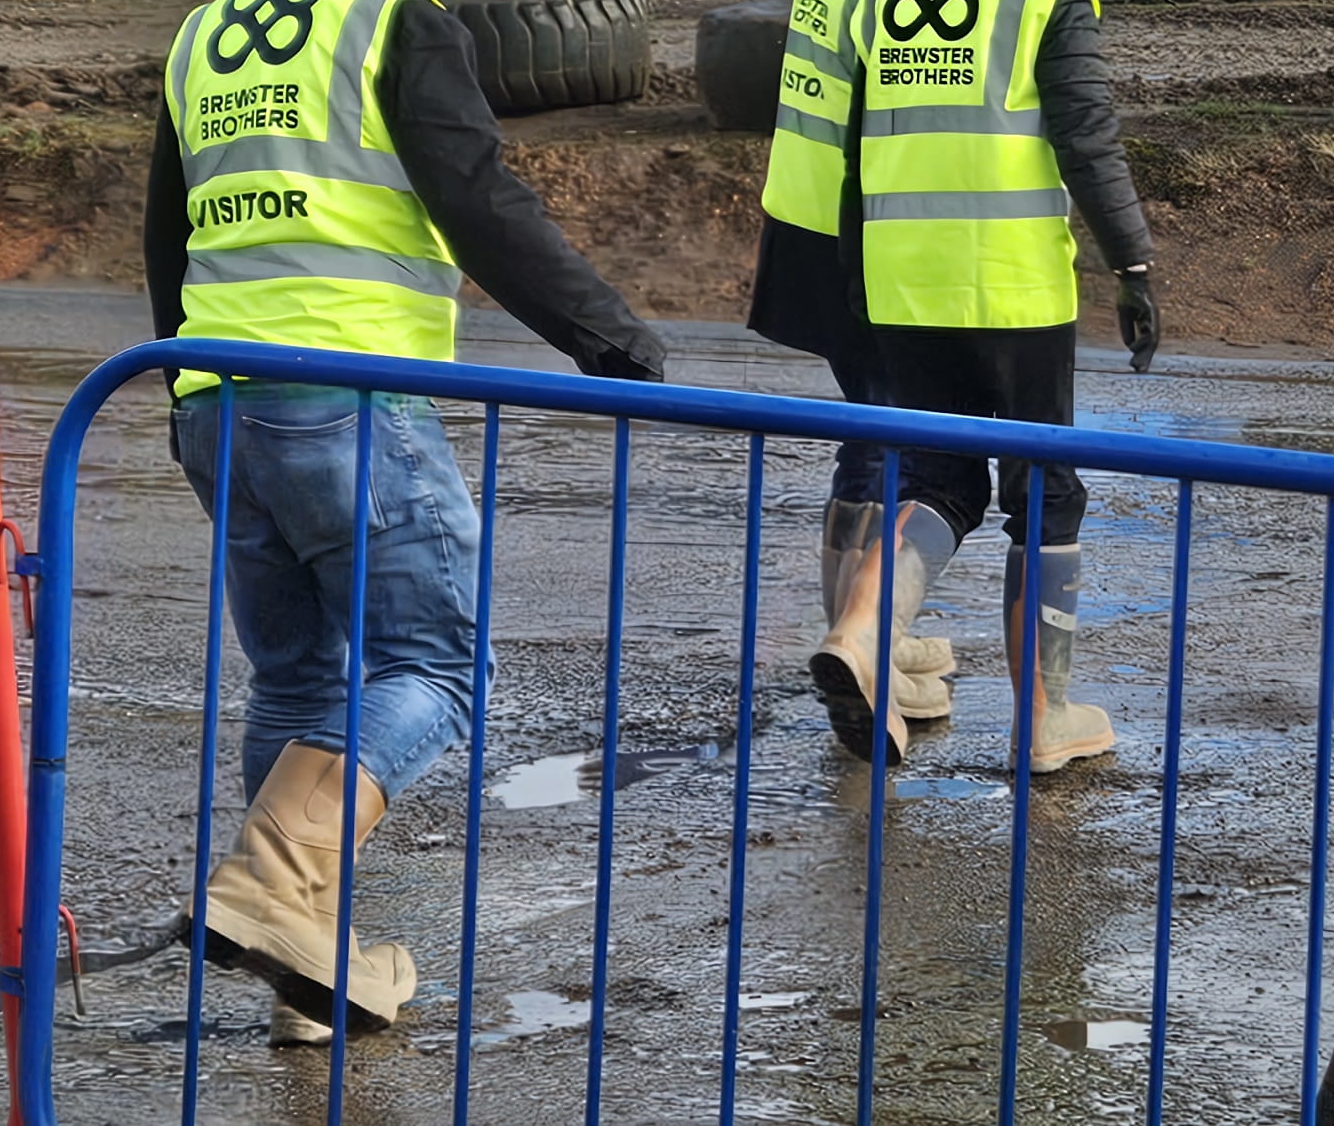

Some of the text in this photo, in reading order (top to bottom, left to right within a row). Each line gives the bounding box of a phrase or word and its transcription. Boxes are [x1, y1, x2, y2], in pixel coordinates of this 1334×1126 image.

[879, 47, 974, 64] BREWSTER
[879, 68, 974, 85] BROTHERS
[199, 84, 299, 115] BREWSTER
[201, 109, 299, 140] BROTHERS
[192, 190, 309, 228] VISITOR
